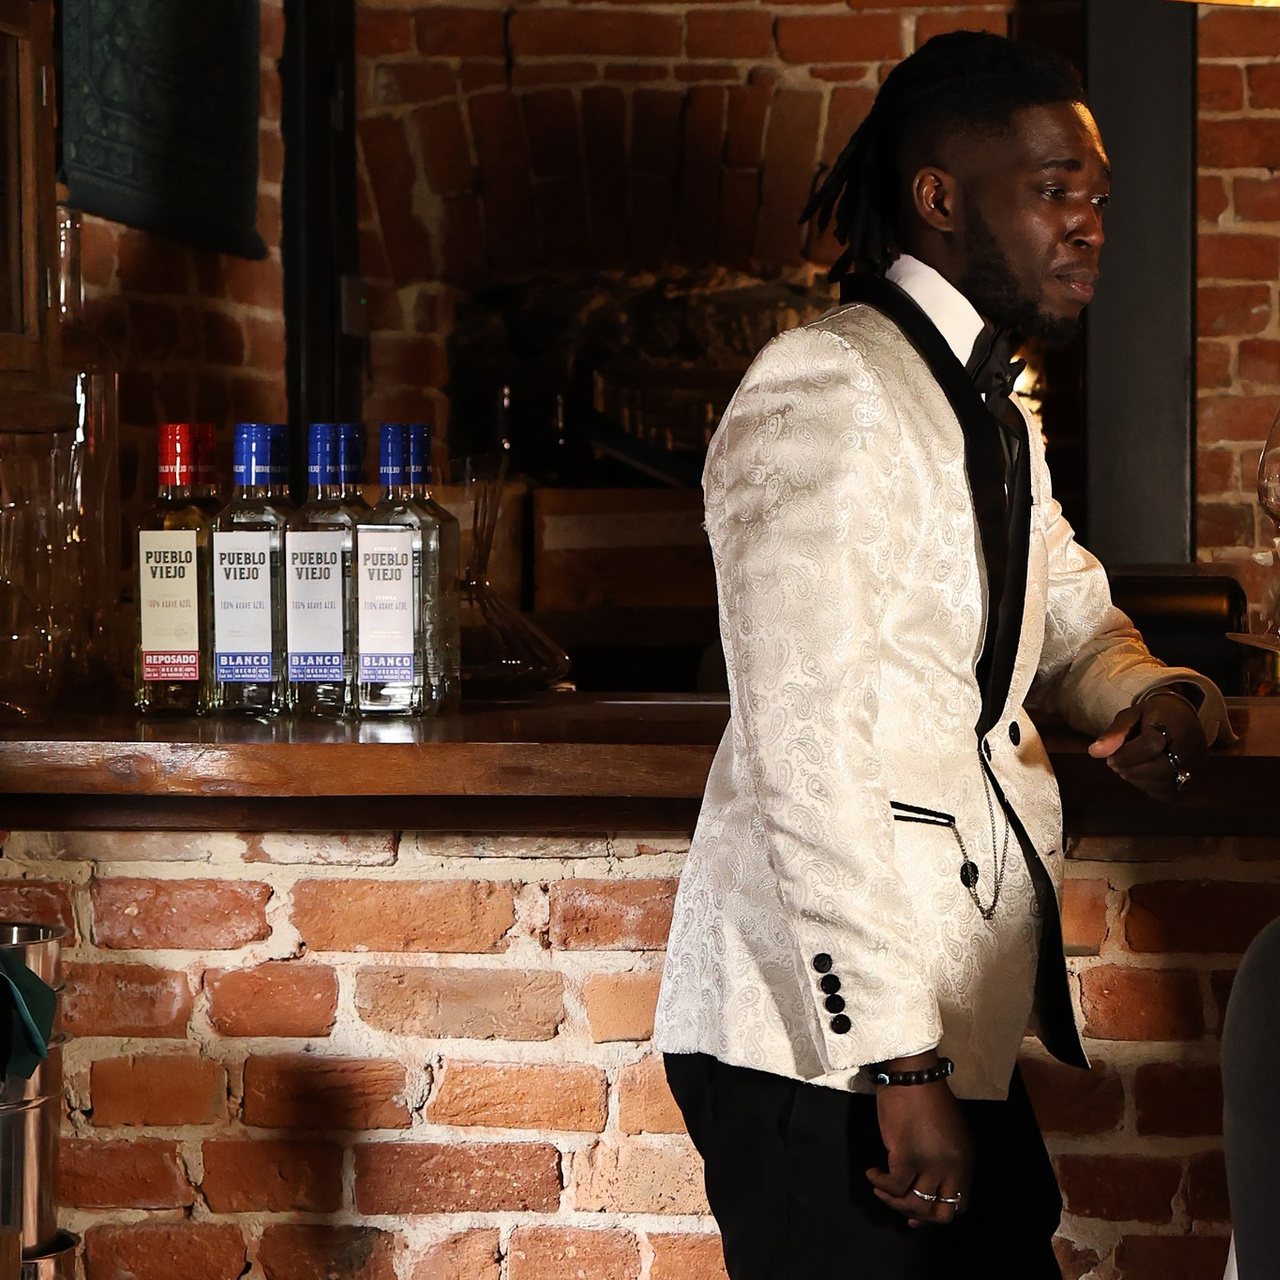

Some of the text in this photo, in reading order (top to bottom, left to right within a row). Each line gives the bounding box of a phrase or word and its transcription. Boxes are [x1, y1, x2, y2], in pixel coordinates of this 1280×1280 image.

[146, 551, 192, 564] PUEBLO
[219, 552, 265, 565] PUEBLO
[292, 552, 337, 565] PUEBLO
[363, 553, 409, 566] PUEBLO
[150, 566, 185, 579] VIEJO
[224, 568, 258, 580] VIEJO
[296, 567, 331, 580] VIEJO
[368, 568, 402, 581] VIEJO
[146, 655, 196, 664] REPOSADO
[220, 656, 268, 665] BLANCO
[292, 656, 340, 665] BLANCO
[363, 656, 411, 666] BLANCO
